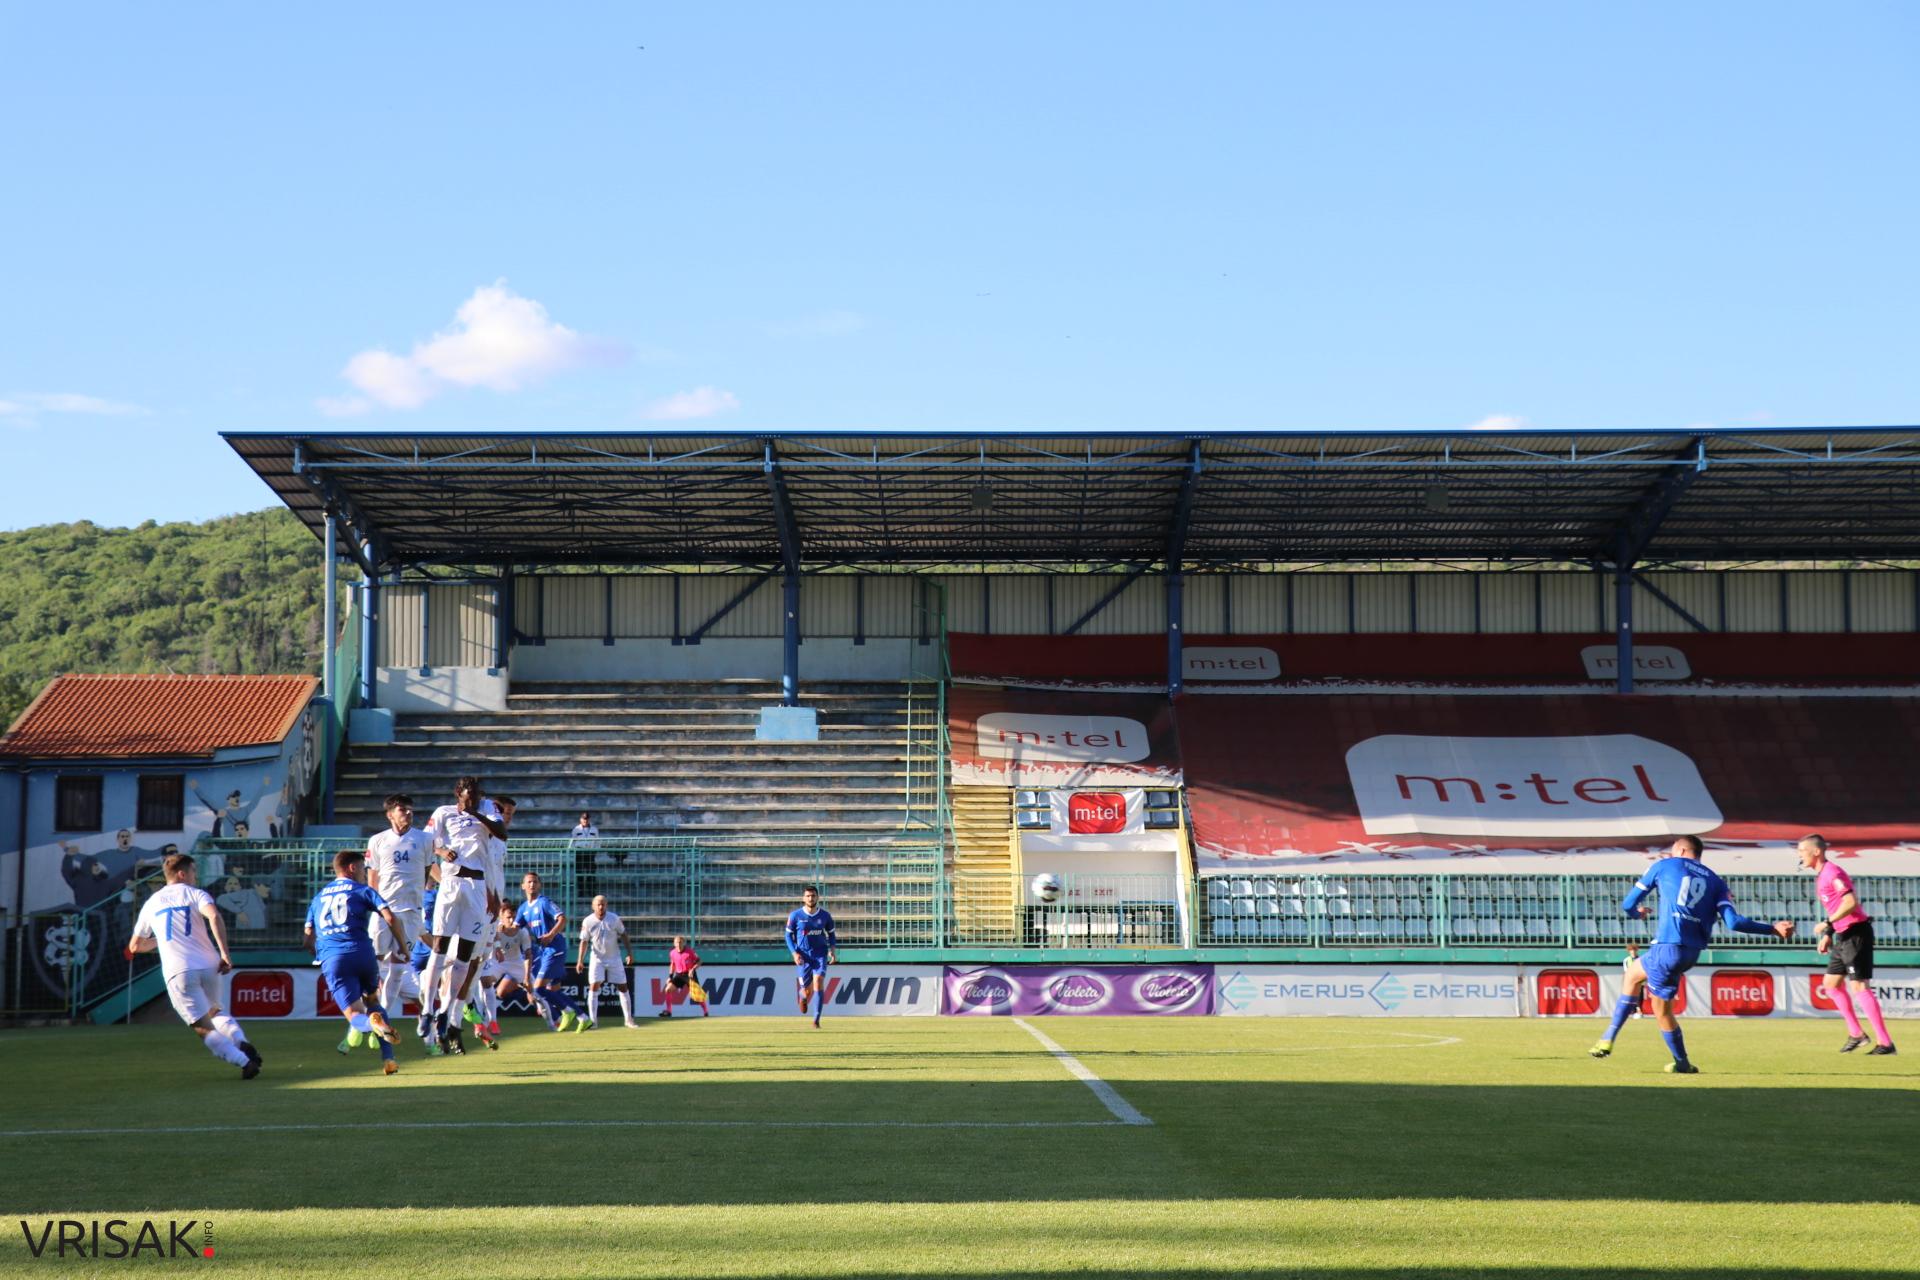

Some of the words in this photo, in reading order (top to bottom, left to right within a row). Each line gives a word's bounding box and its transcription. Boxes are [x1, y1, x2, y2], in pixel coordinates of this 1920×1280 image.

[1190, 656, 1268, 671] m:tel
[1595, 655, 1677, 670] mtel
[1000, 729, 1128, 748] m:tel
[1395, 764, 1670, 805] m:tel
[1074, 803, 1120, 821] m:tel
[393, 850, 410, 864] 34
[1677, 875, 1707, 909] 19
[155, 905, 192, 941] 77
[237, 986, 286, 1003] m:tel
[965, 979, 1006, 998] Violeta
[1056, 978, 1099, 998] Violeta
[1146, 982, 1189, 998] Violeta
[1264, 984, 1364, 998] EMERUS
[1414, 984, 1514, 998] EMERUS
[1543, 983, 1593, 1001] m:tel
[1716, 984, 1768, 1002] m:tel
